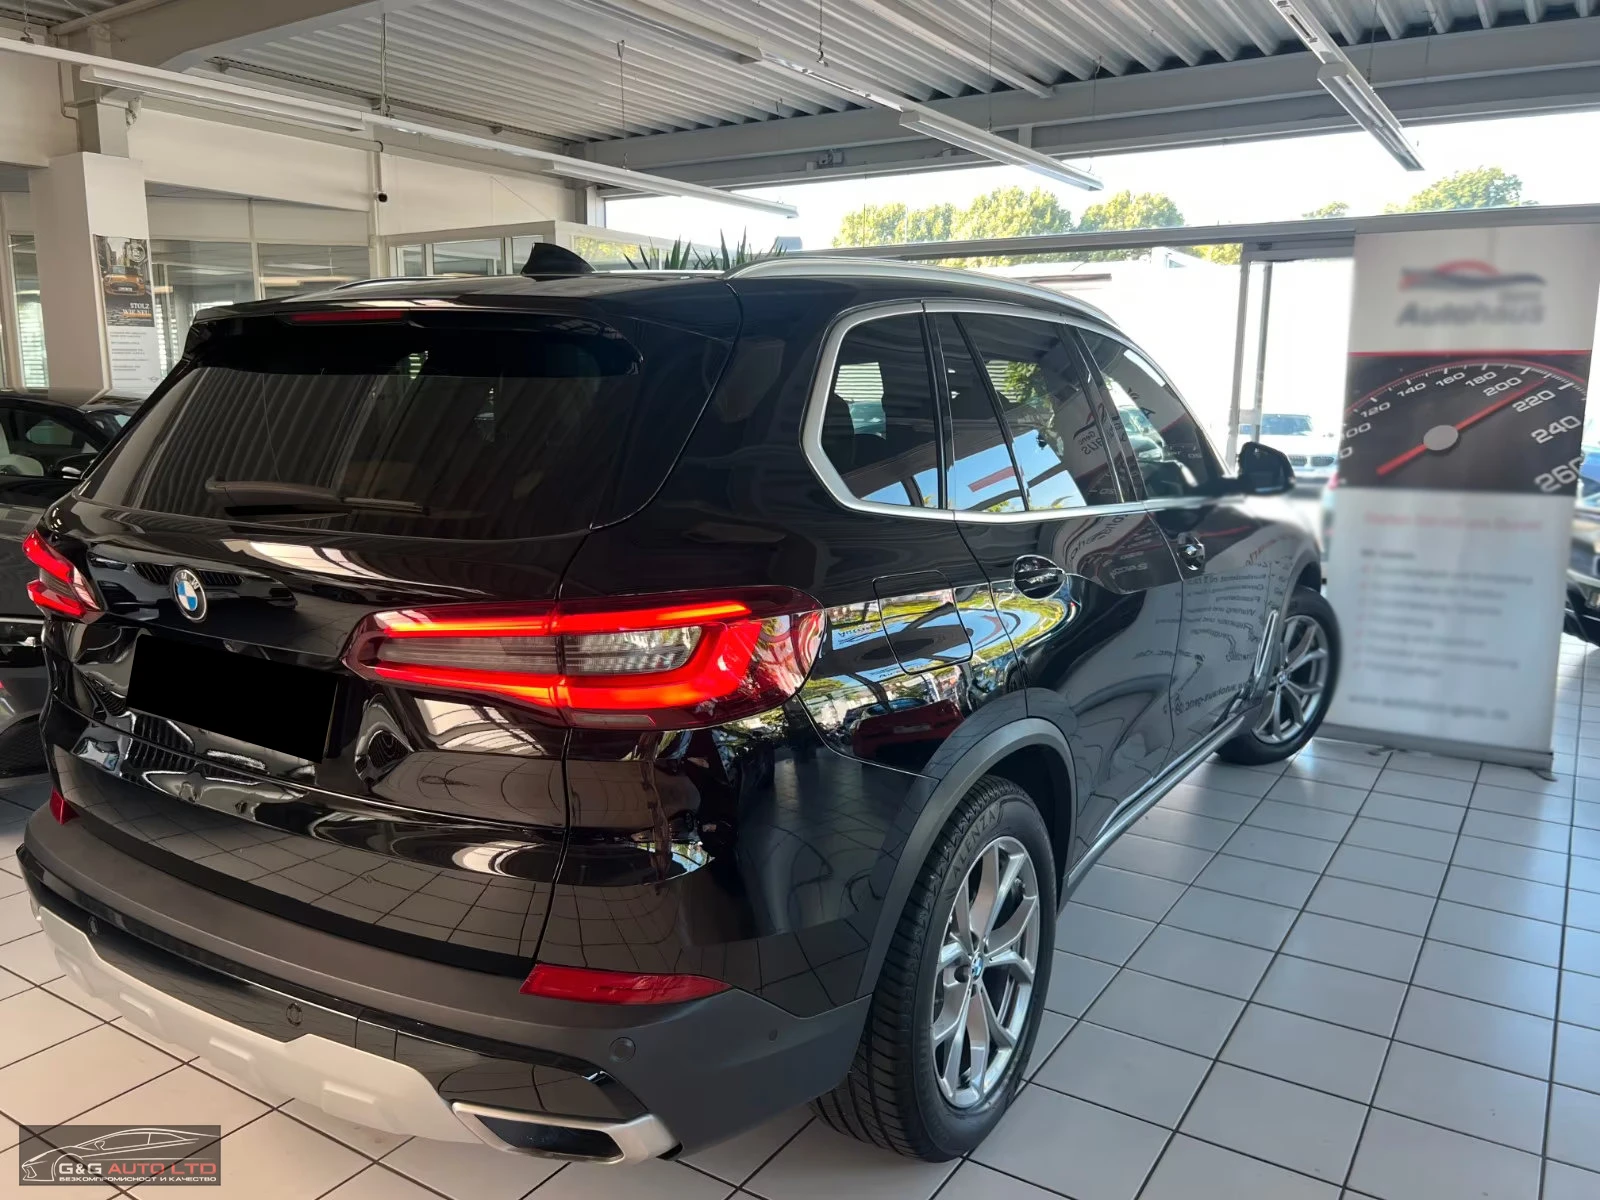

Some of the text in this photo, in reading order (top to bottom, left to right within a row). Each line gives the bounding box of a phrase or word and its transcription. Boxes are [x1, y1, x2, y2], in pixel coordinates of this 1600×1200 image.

[1436, 371, 1466, 387] 160
[1465, 371, 1497, 388] 180
[1483, 377, 1523, 397] 200
[1397, 382, 1427, 398] 140
[1361, 401, 1391, 418] 120
[1512, 390, 1556, 413] 220
[1342, 423, 1372, 438] 00
[1531, 415, 1581, 444] 240
